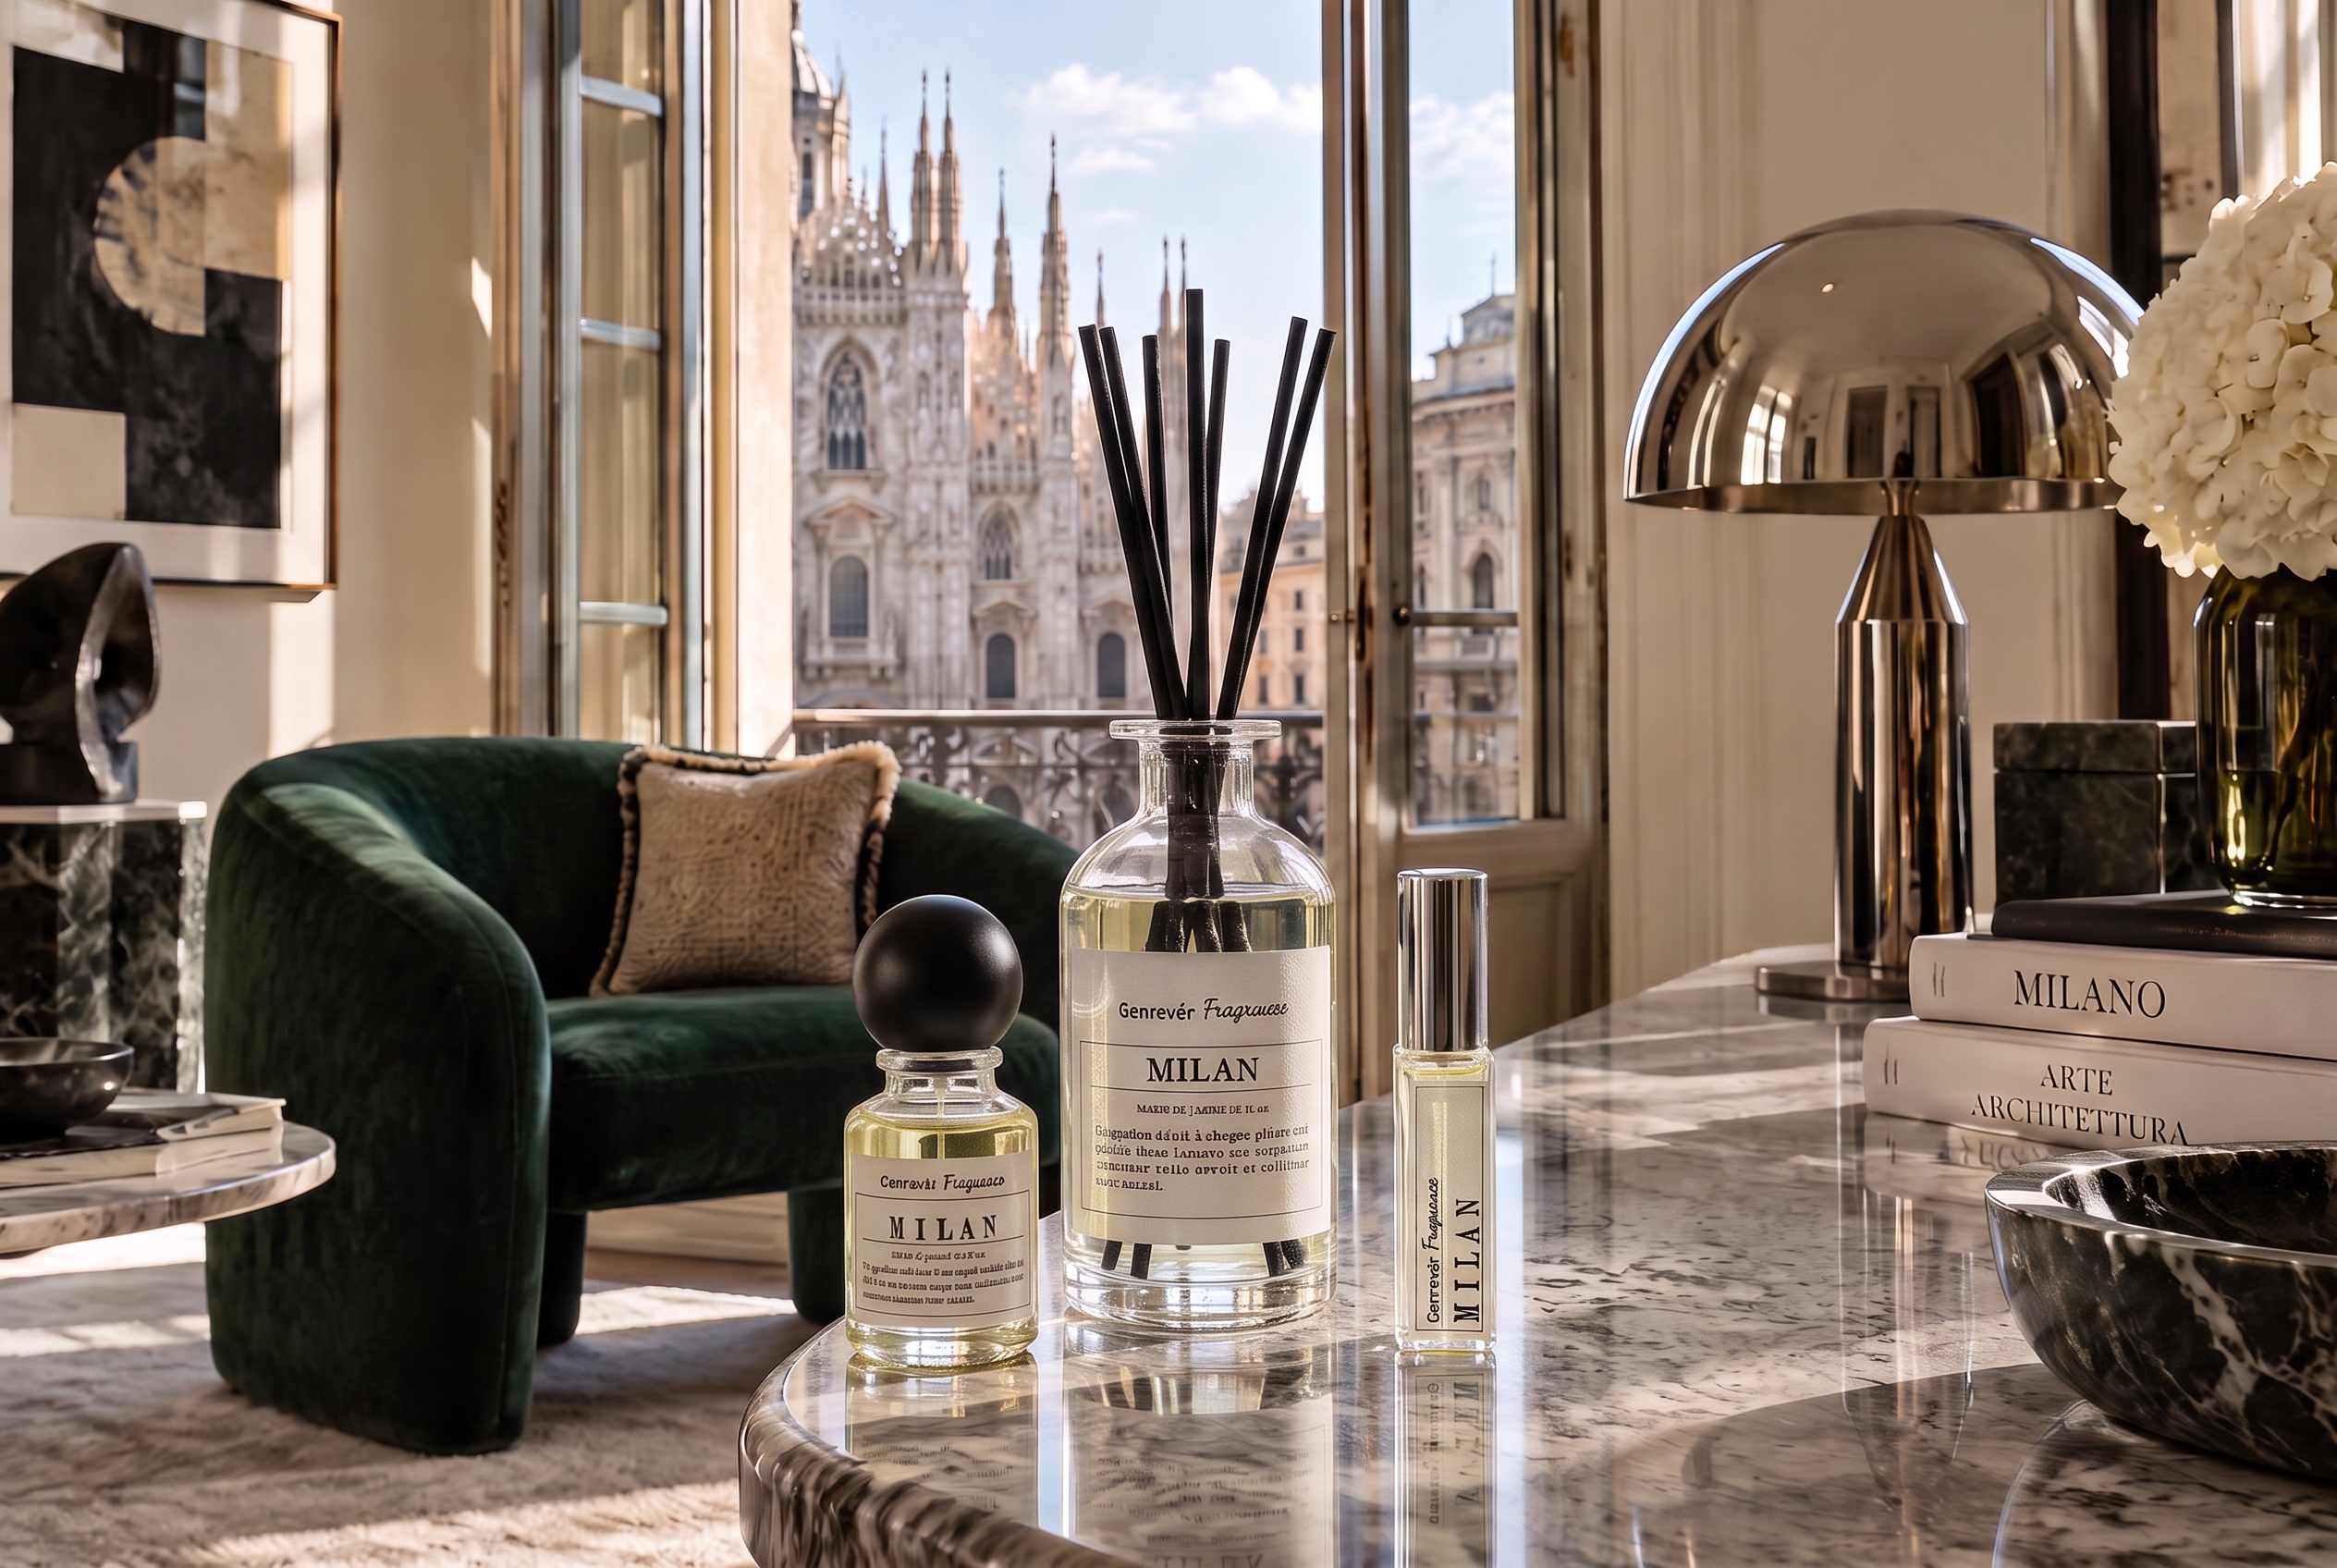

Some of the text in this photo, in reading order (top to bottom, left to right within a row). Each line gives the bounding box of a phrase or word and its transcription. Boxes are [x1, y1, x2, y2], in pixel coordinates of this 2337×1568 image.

[2013, 970, 2165, 1018] MILANO
[1119, 1001, 1196, 1021] Genrevér
[1146, 1057, 1259, 1082] MILAN
[2040, 1064, 2113, 1096] ARTE
[1971, 1094, 2189, 1146] ARCHITETTURA
[889, 1214, 997, 1241] MILAN
[1454, 1199, 1480, 1322] MILAN
